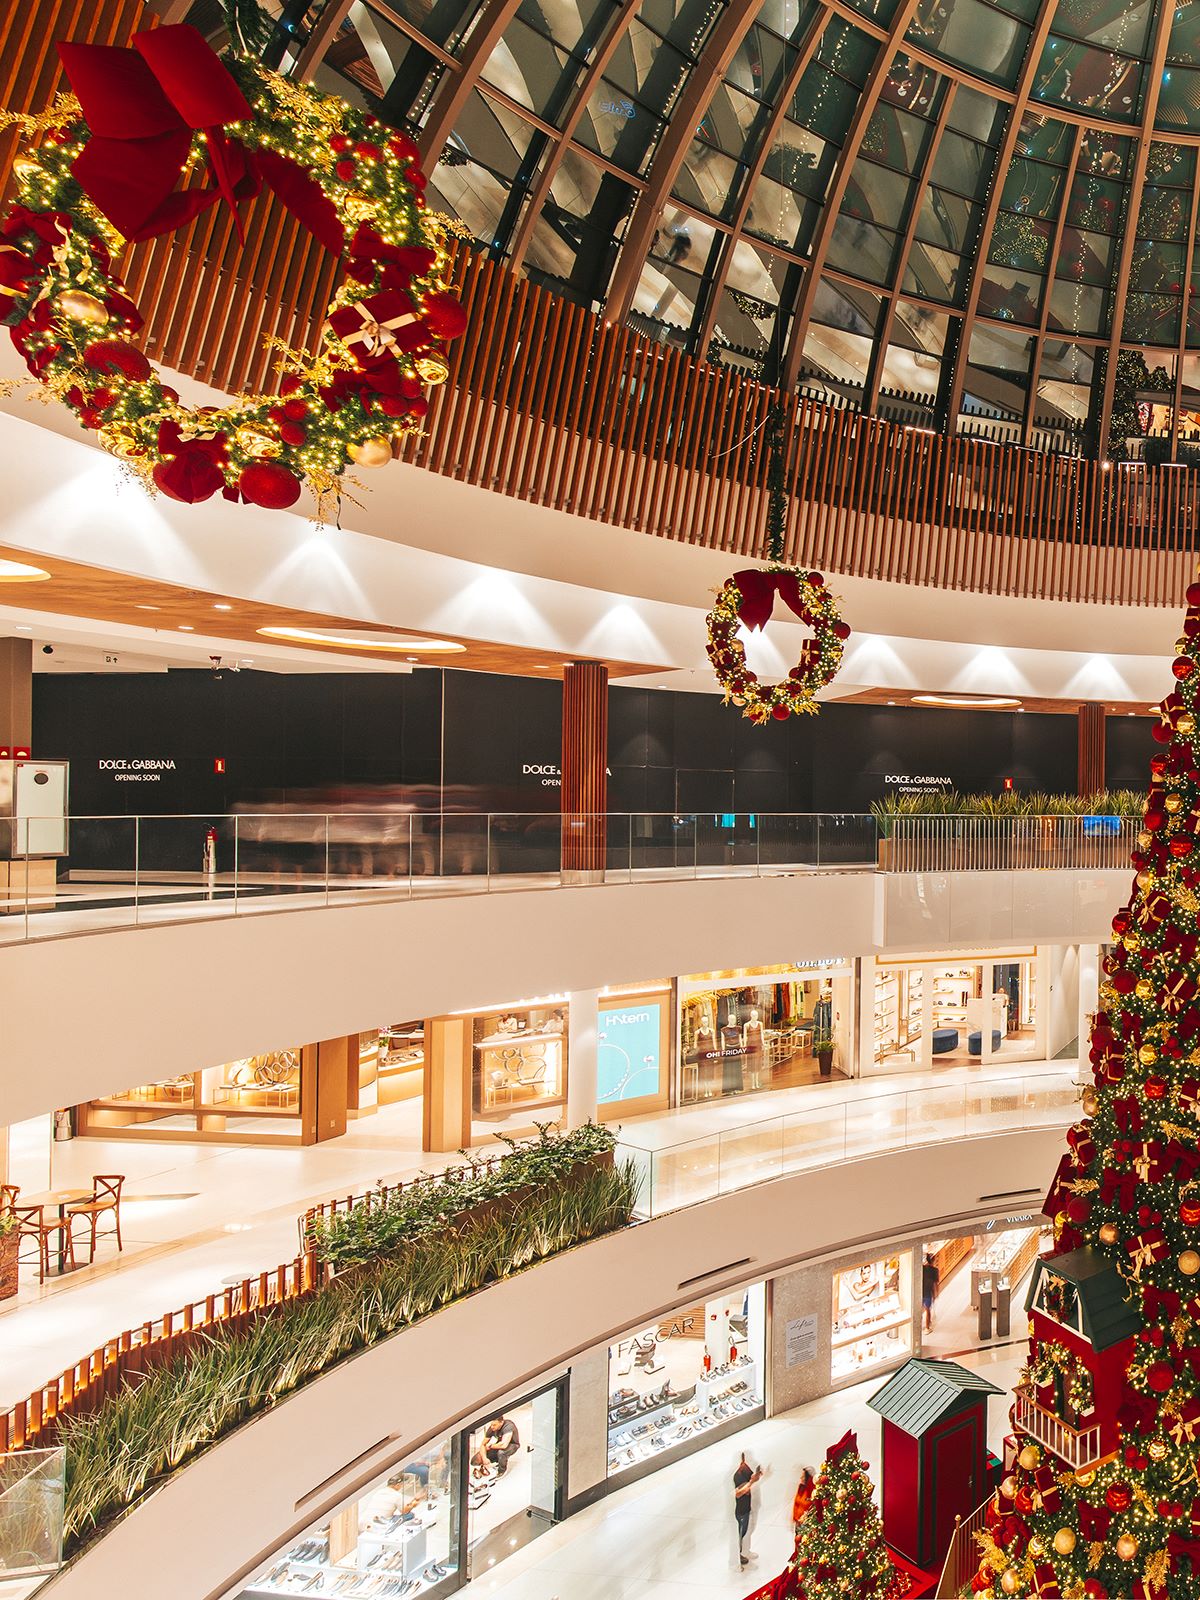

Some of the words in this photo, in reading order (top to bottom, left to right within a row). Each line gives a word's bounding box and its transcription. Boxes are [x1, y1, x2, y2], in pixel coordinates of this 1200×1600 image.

[721, 1047, 748, 1057] FRIDAY
[1006, 1214, 1033, 1223] VIVARA
[618, 1316, 695, 1358] FASCAR
